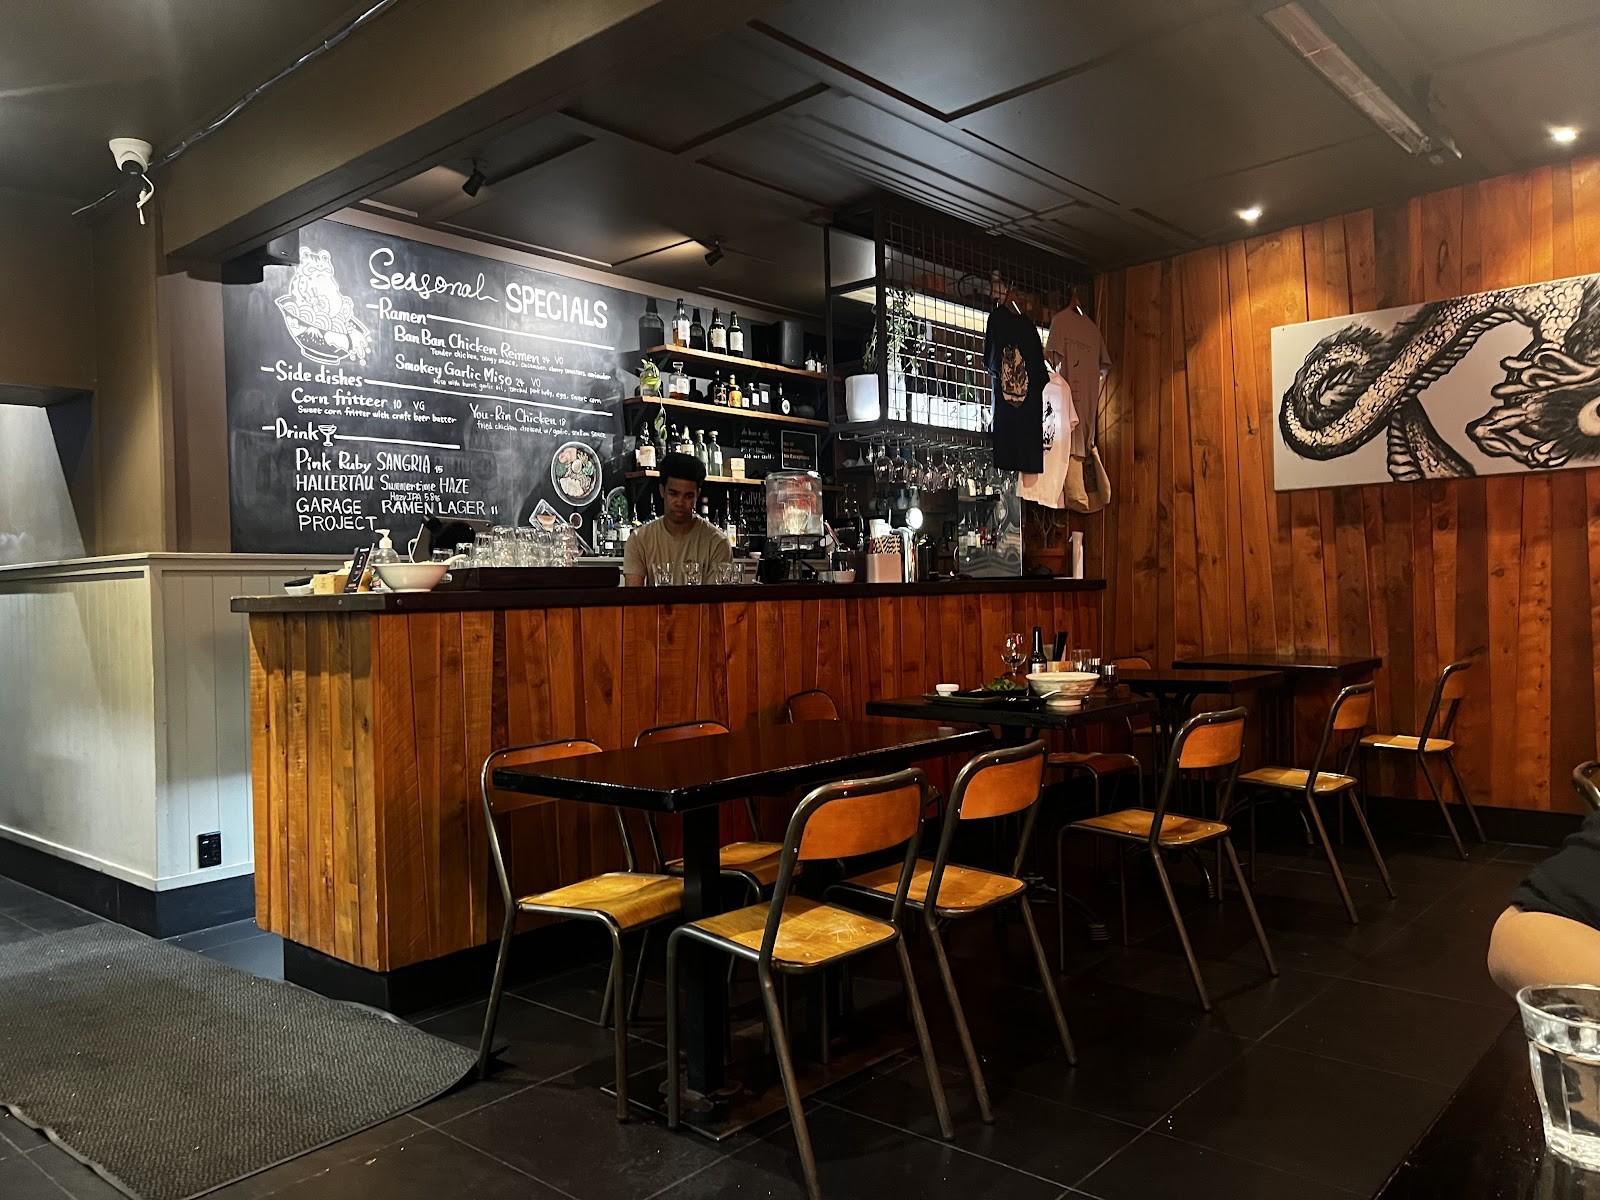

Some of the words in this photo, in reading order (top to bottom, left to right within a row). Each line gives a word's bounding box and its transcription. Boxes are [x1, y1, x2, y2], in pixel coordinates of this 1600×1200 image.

[368, 247, 499, 302] Seasonal
[505, 282, 608, 329] SPECIALS
[378, 296, 428, 325] Ramen
[393, 325, 420, 345] Ban
[420, 330, 446, 348] Ban
[448, 333, 498, 356] Chicken
[500, 342, 540, 365] Reimen
[276, 360, 312, 382] Side
[315, 365, 363, 387] dishes
[395, 354, 442, 379] Smokey
[443, 361, 482, 381] Garlic
[483, 367, 513, 386] Miso
[515, 378, 524, 387] 24
[291, 387, 330, 405] Corn
[392, 399, 402, 409] 10
[413, 400, 425, 412] VG
[323, 408, 343, 416] corn
[344, 406, 371, 418] fritter
[372, 410, 390, 420] with
[391, 410, 411, 422] craft
[413, 412, 431, 423] beer
[514, 407, 557, 426] Chicken
[275, 417, 319, 441] Drink
[494, 422, 517, 432] chicken
[295, 447, 332, 472] Pink
[338, 450, 372, 475] Ruby
[376, 451, 431, 475] SANGRIA
[434, 465, 444, 474] 15
[295, 473, 374, 492] HALLERTAU
[380, 473, 437, 492] Summertime
[439, 476, 470, 494] HAZE
[295, 497, 362, 515] GARAGE
[381, 499, 434, 515] RAMEN
[437, 500, 486, 515] LAGER
[406, 492, 422, 502] IPA
[298, 514, 378, 532] PROJECT
